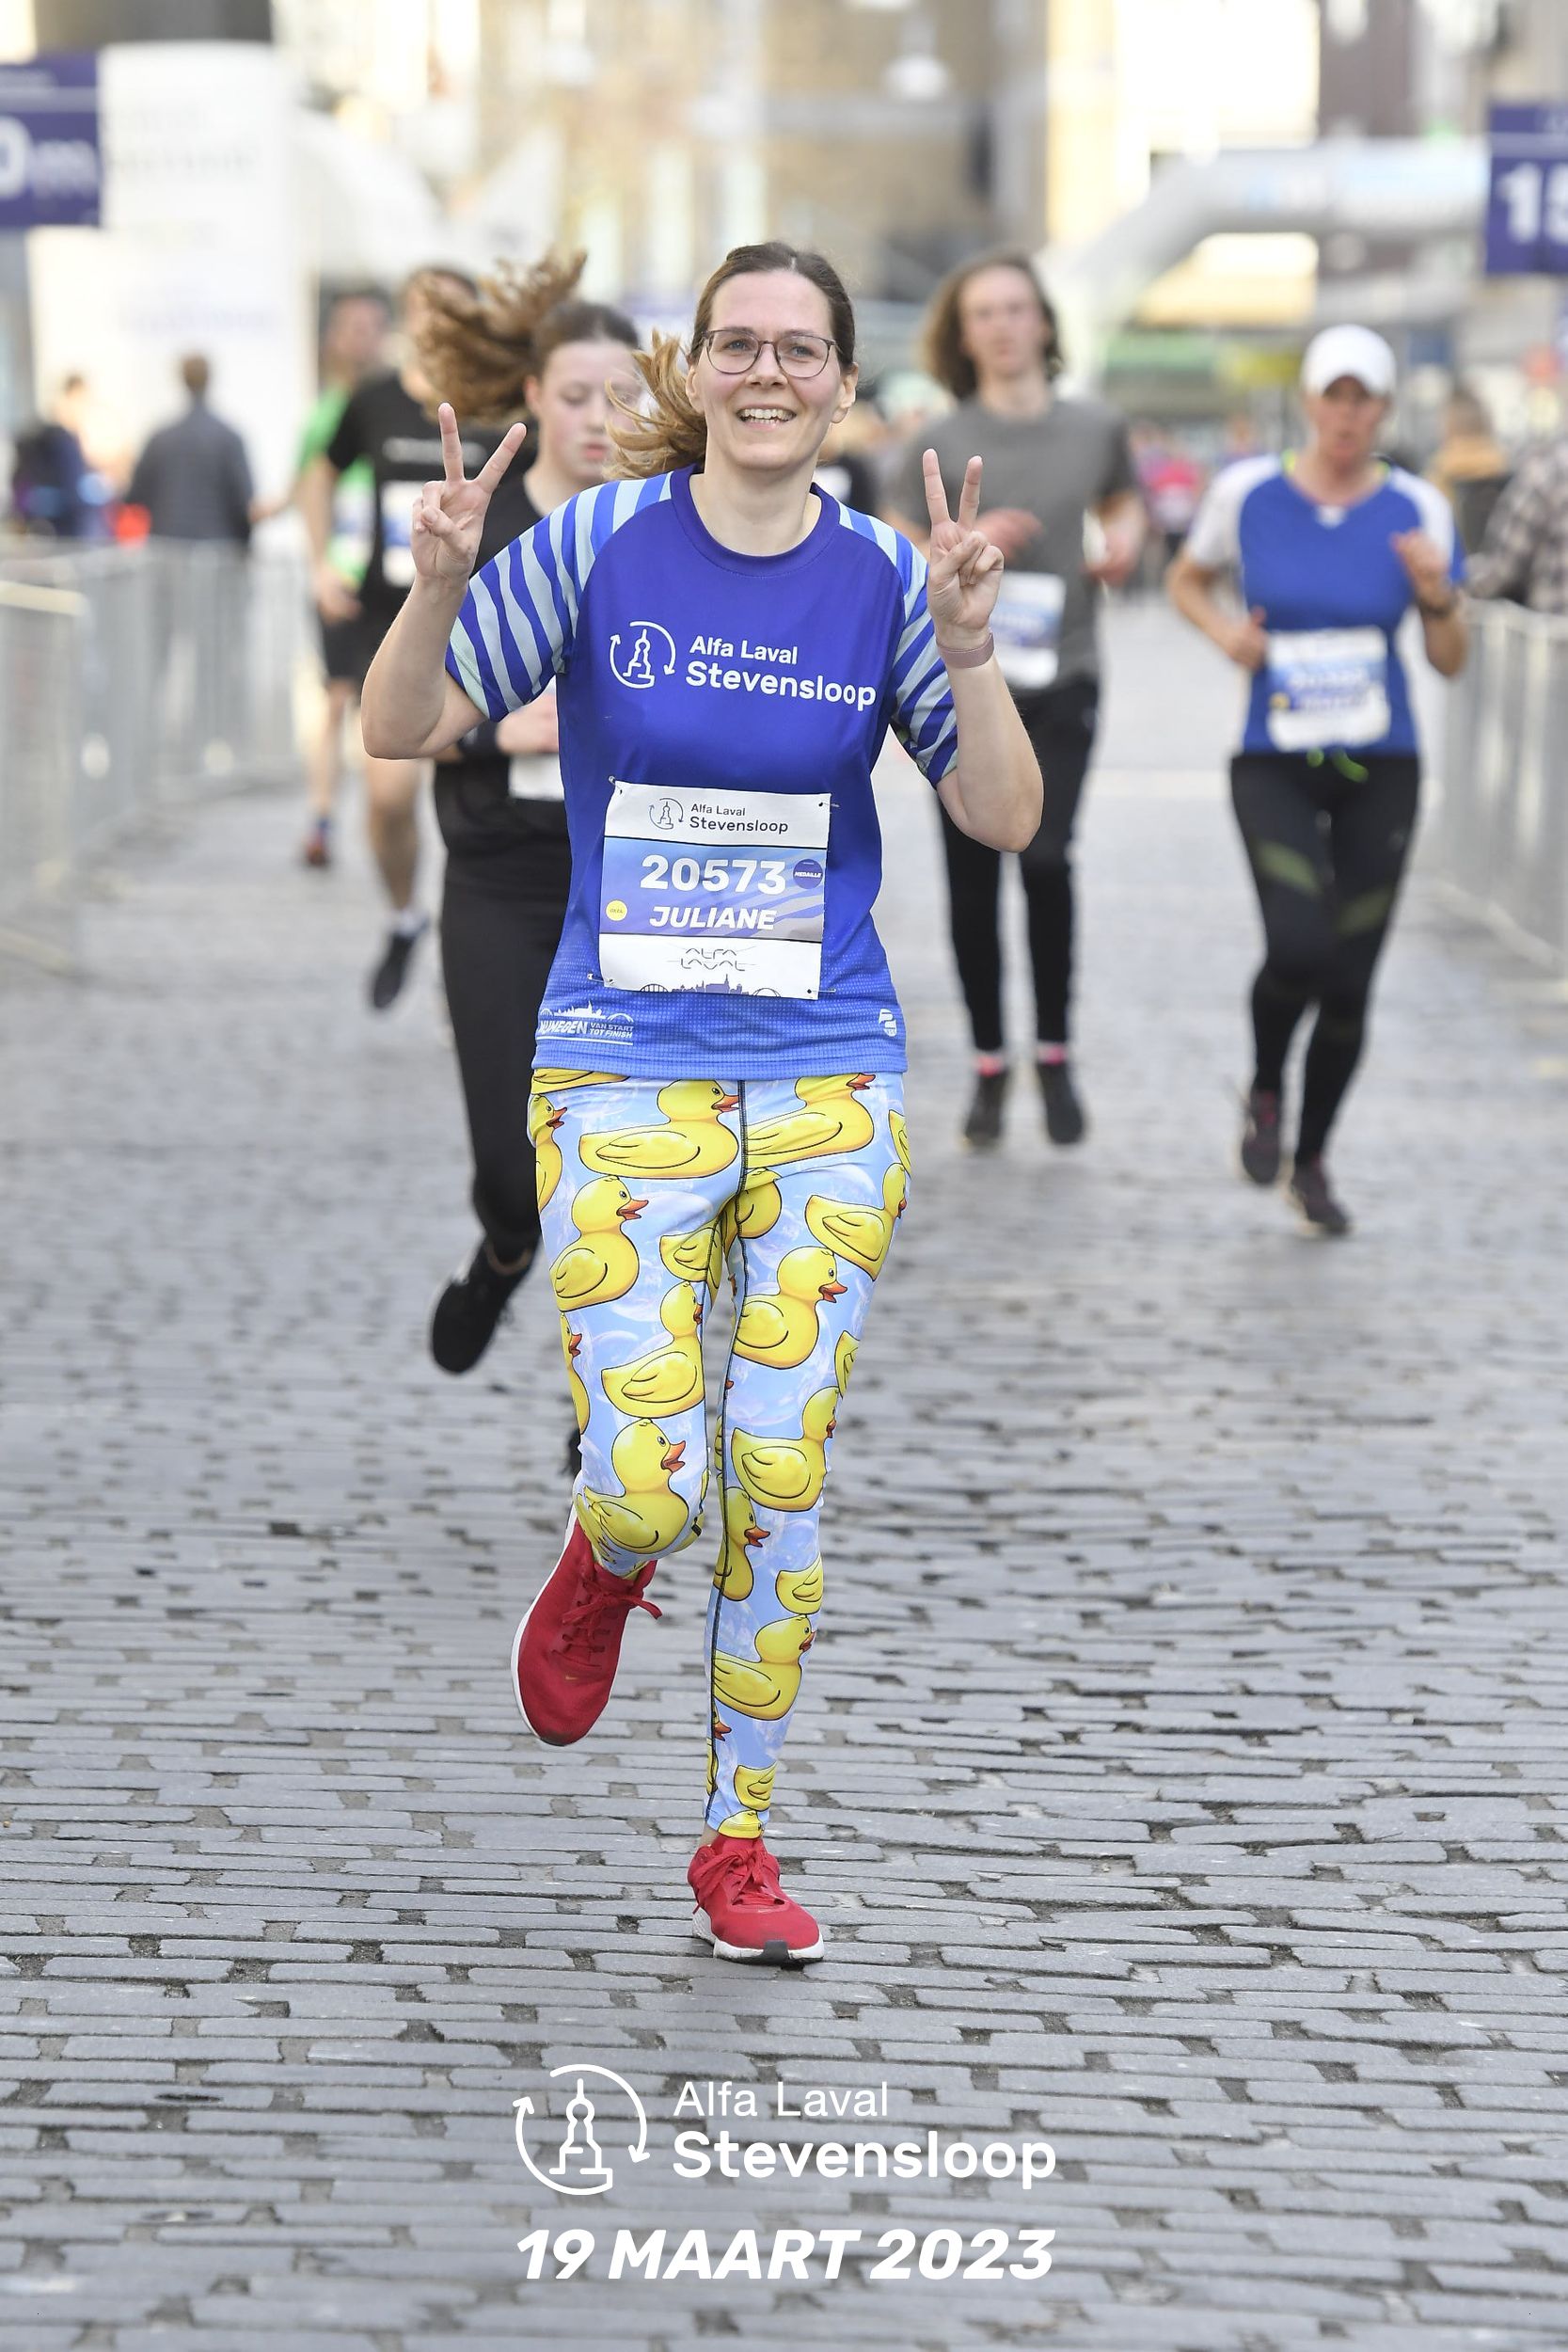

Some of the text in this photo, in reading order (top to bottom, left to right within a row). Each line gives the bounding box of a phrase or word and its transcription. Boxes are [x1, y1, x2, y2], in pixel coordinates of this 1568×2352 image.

[689, 635, 798, 665] Alfa Laval
[686, 660, 877, 711] Stevensloop
[690, 803, 746, 817] Alfa Laval
[689, 816, 789, 834] Stevensloop
[640, 854, 786, 895] 20573
[649, 906, 778, 931] JULIANE
[590, 1022, 634, 1032] VAN START
[605, 1029, 633, 1039] FINISH
